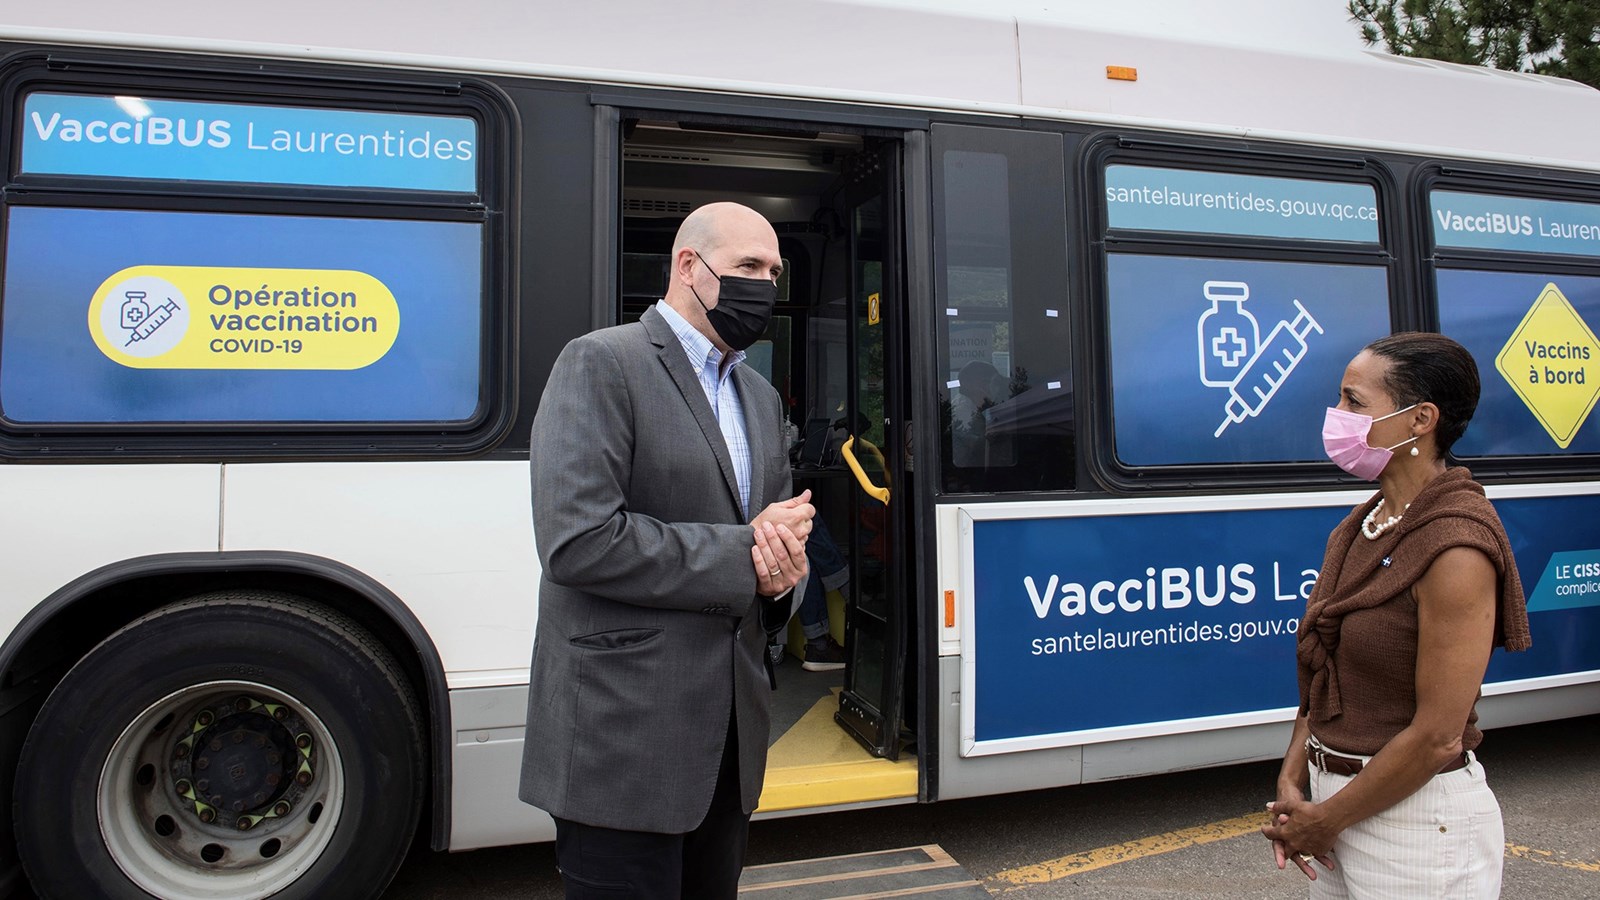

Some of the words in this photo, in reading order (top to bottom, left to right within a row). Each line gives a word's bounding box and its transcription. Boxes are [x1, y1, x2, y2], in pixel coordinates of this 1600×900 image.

[31, 107, 231, 148] VacciBUS
[247, 121, 473, 161] Laurentides
[1106, 185, 1379, 222] santelaurentides.gouv.qc.ca
[1436, 209, 1534, 236] VacciBUS
[208, 284, 357, 310] Opération
[210, 308, 377, 333] vaccination
[209, 338, 303, 354] COVID-19
[1525, 340, 1591, 360] Vaccins
[1529, 365, 1539, 384] à
[1544, 366, 1586, 385] bord
[1556, 565, 1571, 580] LE
[1024, 563, 1256, 619] VacciBUS
